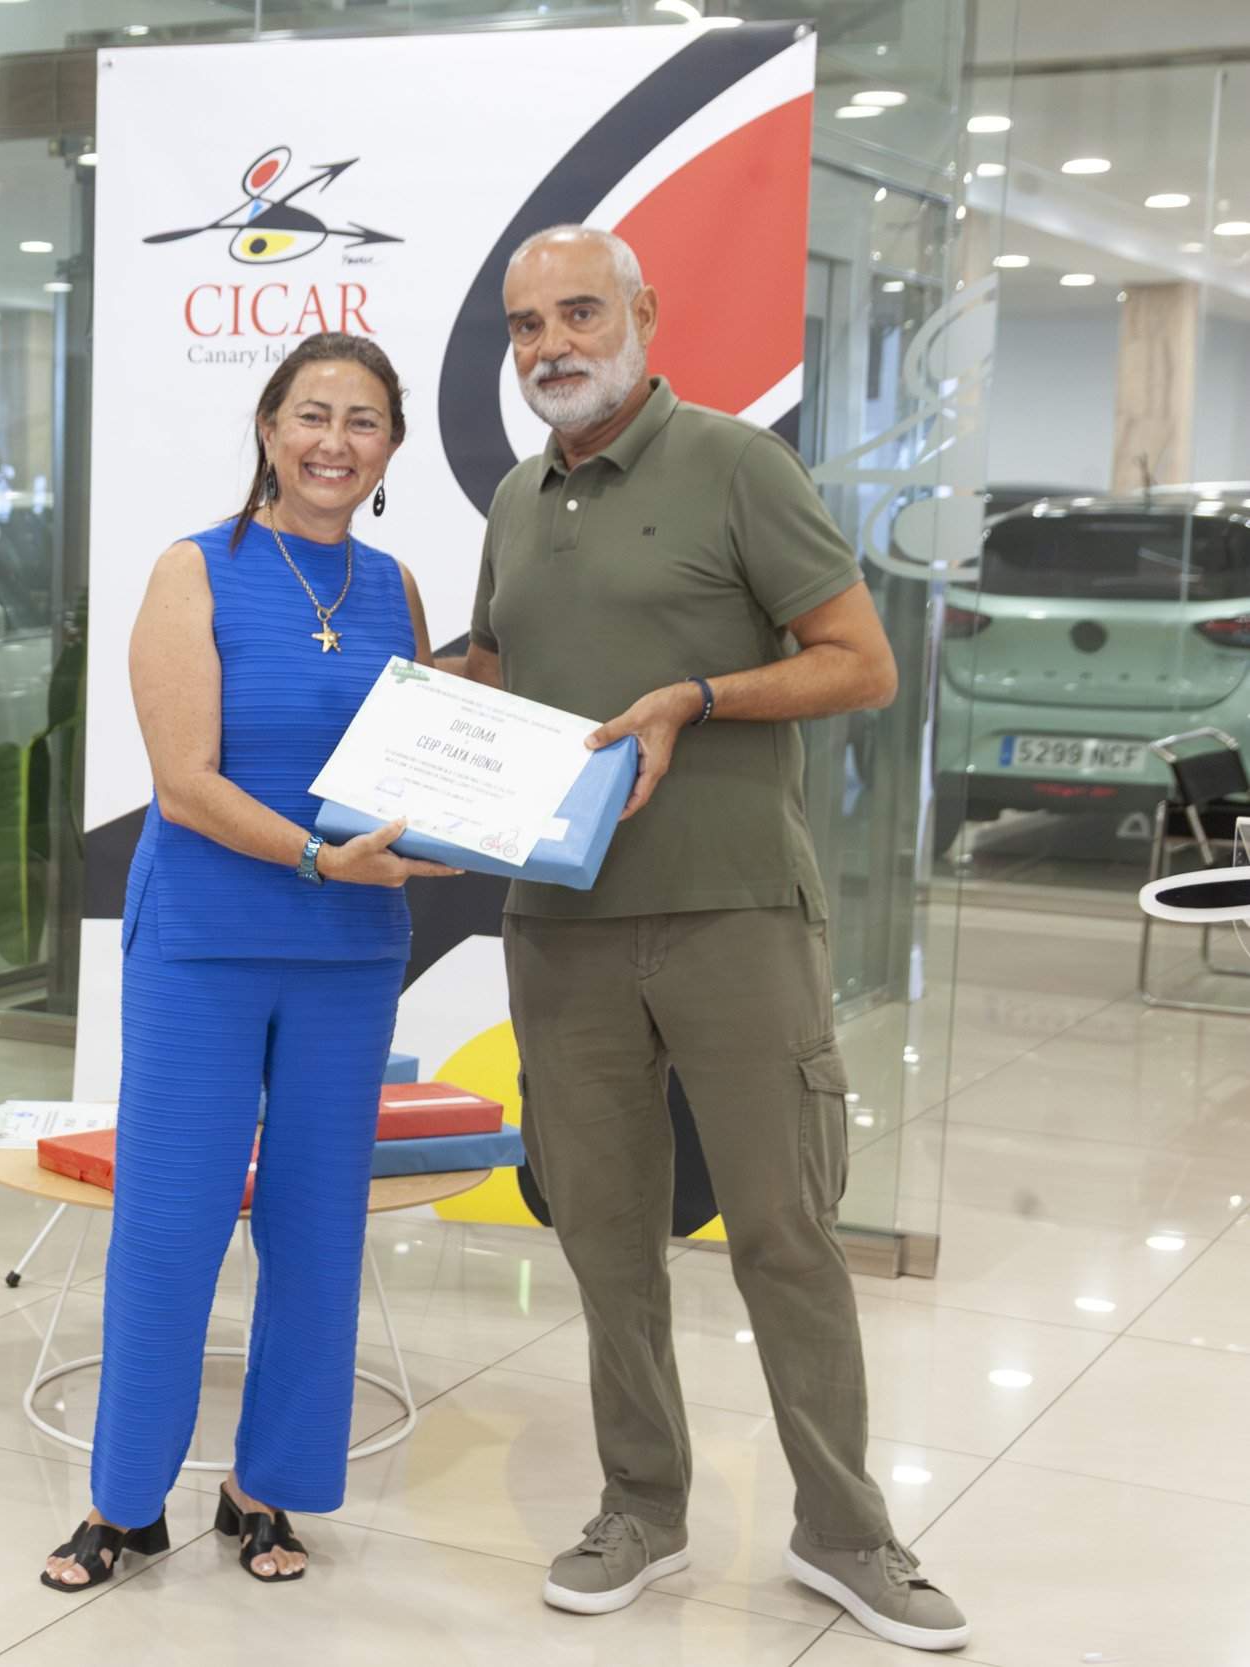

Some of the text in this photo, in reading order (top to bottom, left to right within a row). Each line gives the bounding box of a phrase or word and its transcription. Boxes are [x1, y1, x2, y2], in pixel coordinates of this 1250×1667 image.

[184, 282, 376, 337] CICAR
[187, 343, 256, 368] Canary
[449, 718, 497, 745] DIPLOMA
[416, 734, 442, 752] CEIP
[441, 743, 470, 763] PLAYA
[469, 752, 504, 774] HONDA
